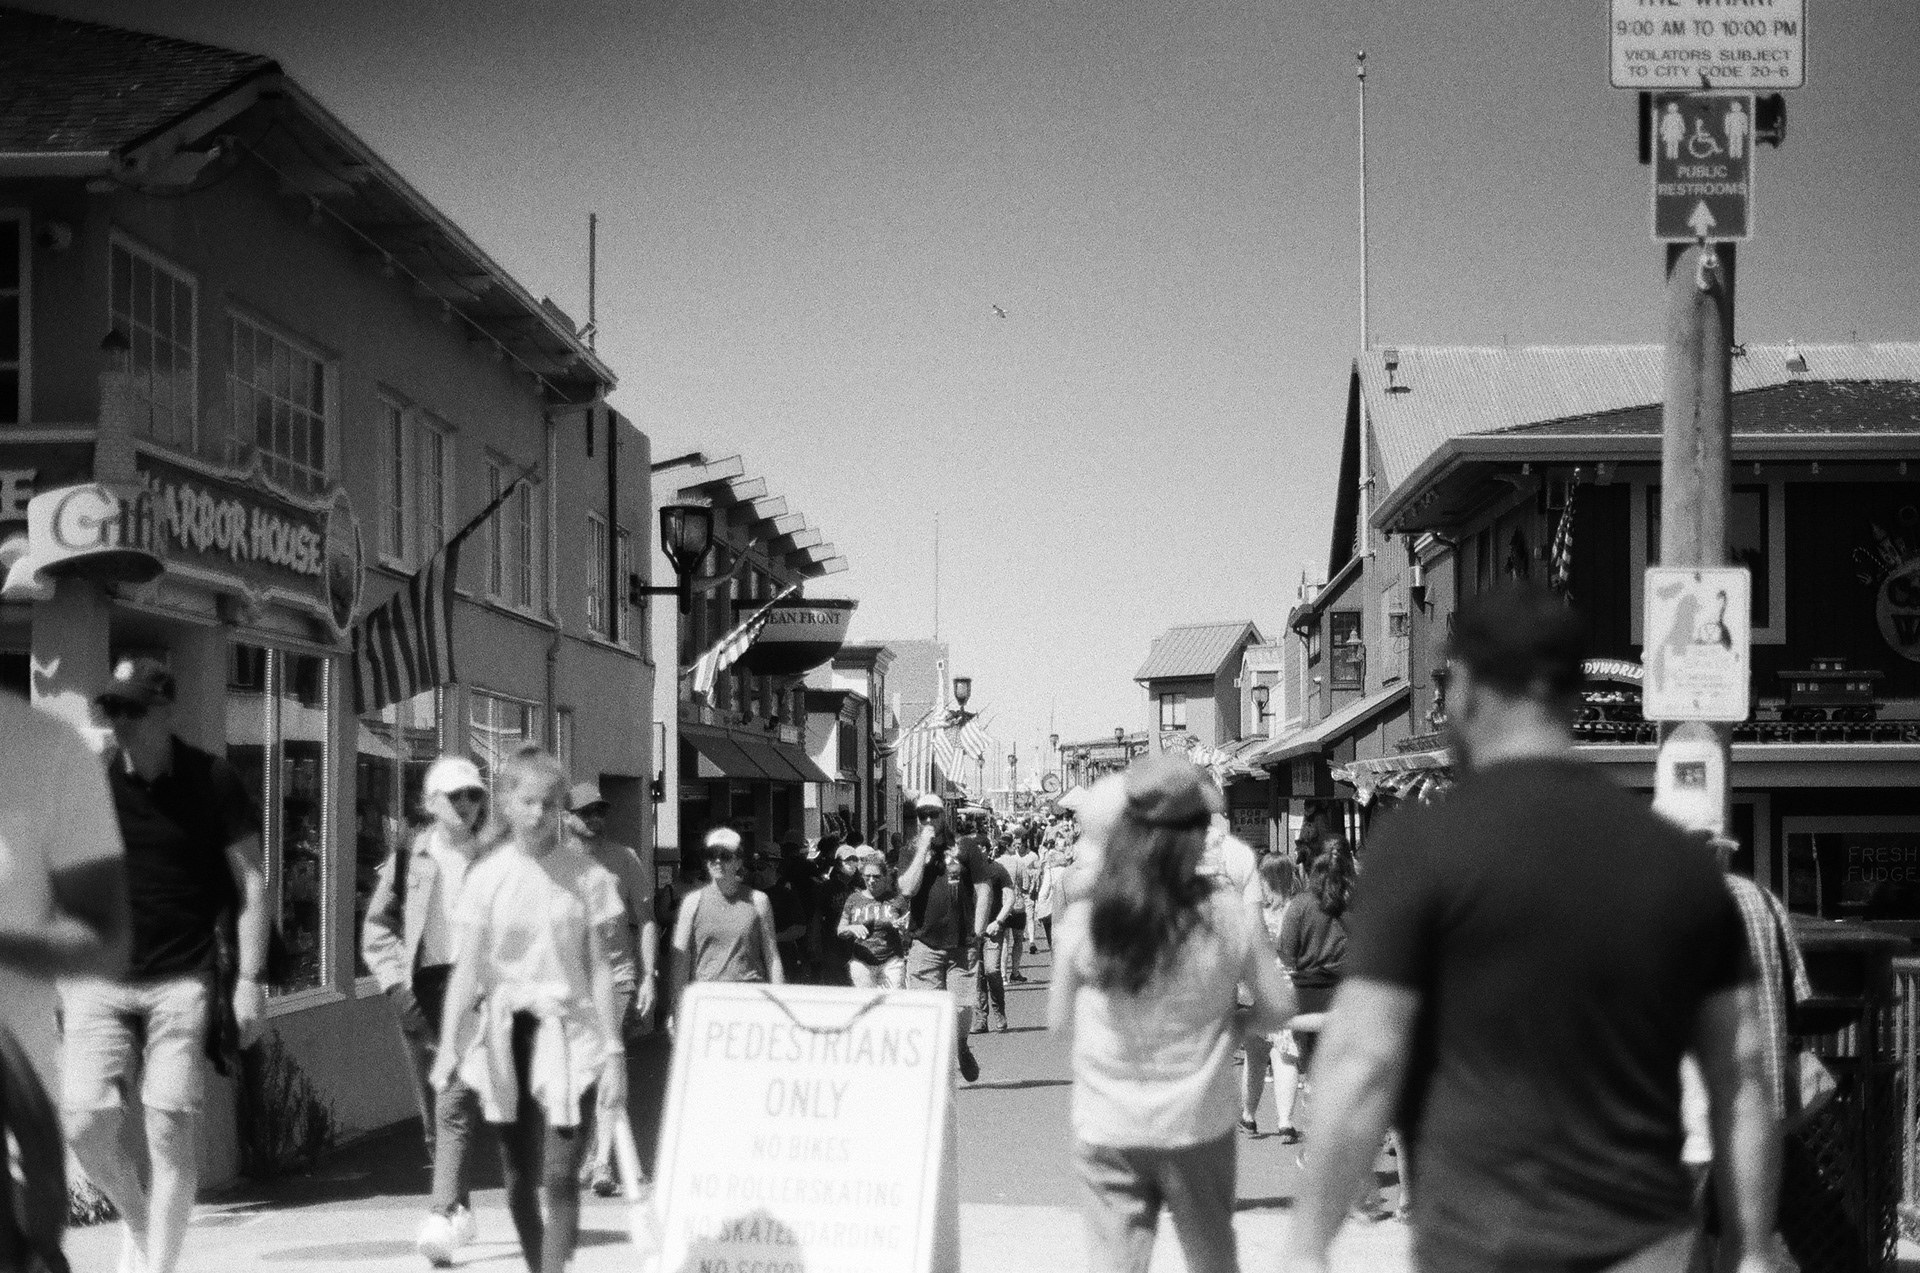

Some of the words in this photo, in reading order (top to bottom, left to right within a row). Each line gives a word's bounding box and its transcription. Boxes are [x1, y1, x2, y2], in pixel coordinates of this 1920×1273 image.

[1616, 19, 1654, 37] 9:00
[1662, 20, 1686, 36] AM
[1692, 20, 1714, 37] TO
[1722, 20, 1767, 37] 10:00
[1773, 20, 1797, 37] PM
[1624, 50, 1712, 61] VIOLATORS
[1719, 50, 1790, 61] SUBJECT
[1629, 65, 1648, 77] TO
[1654, 65, 1690, 77] CITY
[1698, 65, 1743, 78] CODE
[1677, 165, 1729, 178] PUBLIC
[1658, 182, 1748, 196] RESTROOMS
[251, 506, 323, 576] HOUSE
[801, 611, 842, 625] FRONT
[1240, 809, 1262, 817] FOR
[1235, 818, 1268, 826] LEASE
[1848, 846, 1918, 863] FRESH
[1847, 866, 1918, 882] FUDGE
[703, 1020, 923, 1068] PEDESTRIANS
[765, 1076, 851, 1120] ONLY
[752, 1133, 782, 1161] NO
[786, 1135, 852, 1163] BIKES
[690, 1172, 720, 1200] NO
